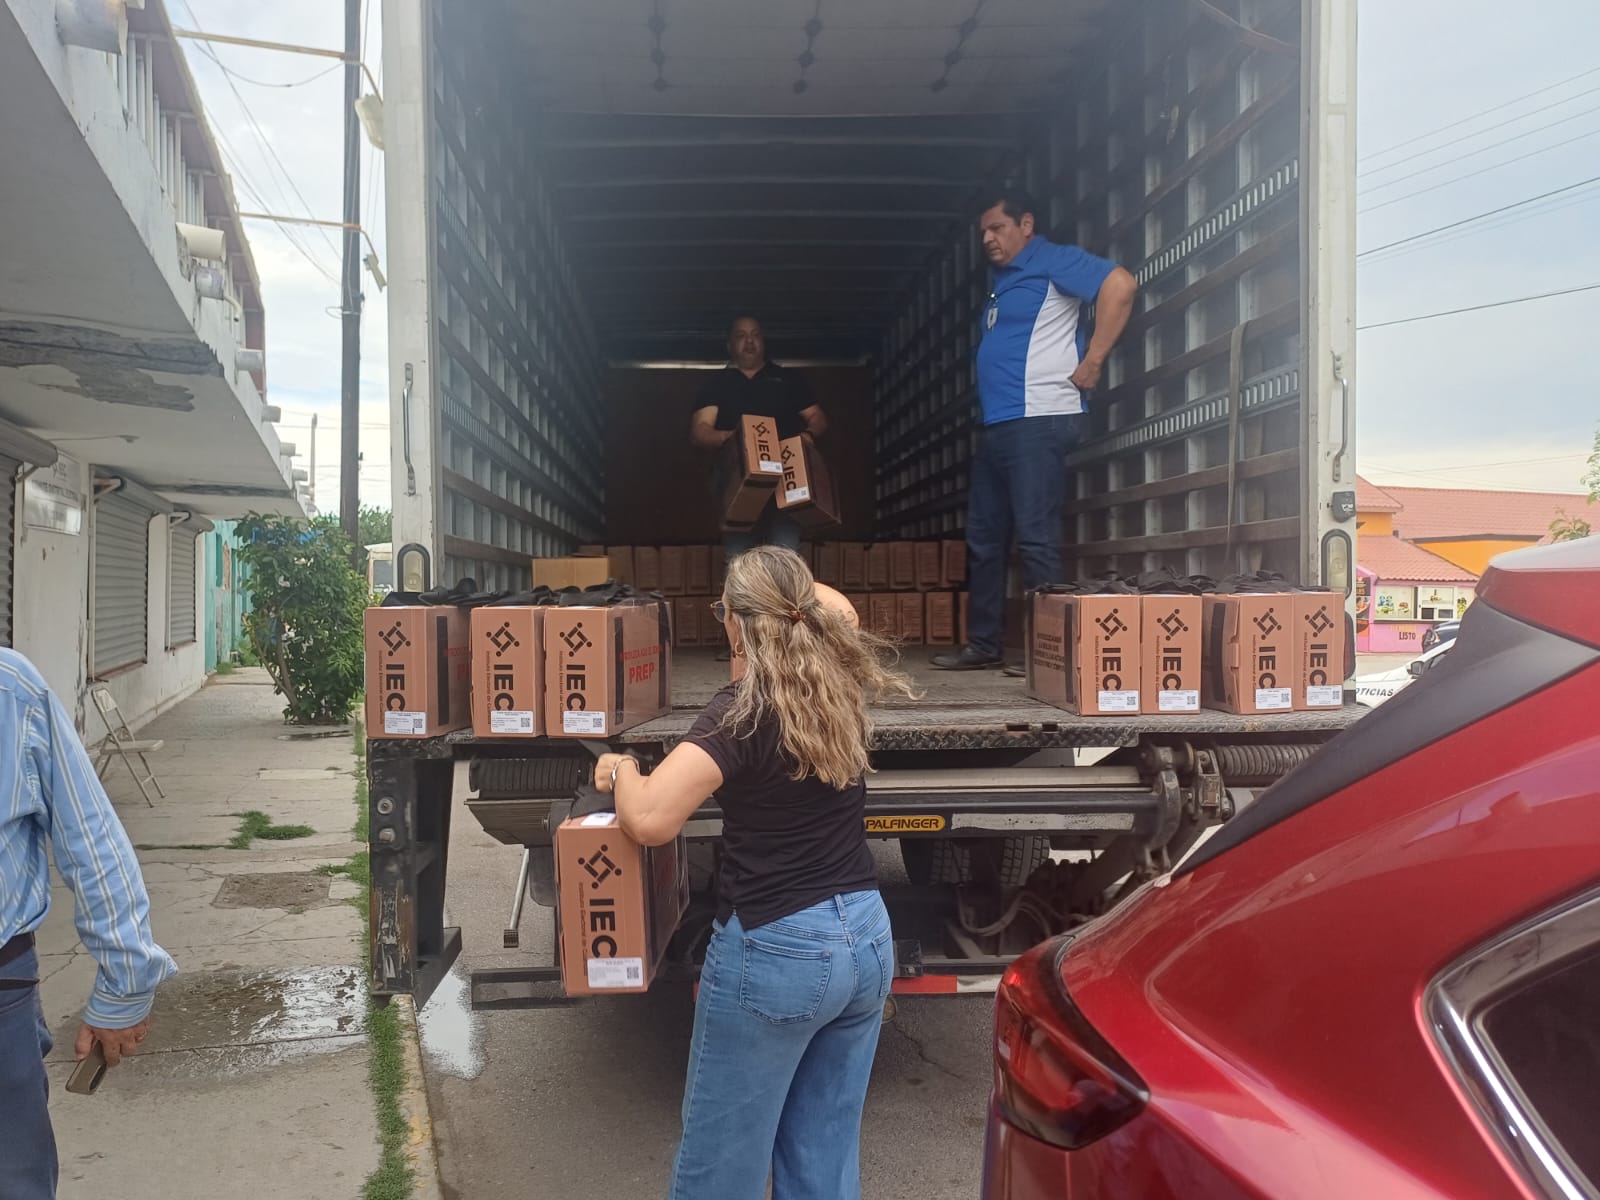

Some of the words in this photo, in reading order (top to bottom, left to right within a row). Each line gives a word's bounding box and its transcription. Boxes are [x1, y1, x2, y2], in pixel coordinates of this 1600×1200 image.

[757, 439, 771, 461] IEC
[783, 466, 797, 491] IEC
[1399, 632, 1416, 640] LISTO
[629, 662, 655, 684] PREP
[1102, 647, 1122, 690] IEC
[1162, 647, 1182, 691] IEC
[1258, 646, 1277, 689] IEC
[1309, 643, 1328, 686] IEC
[386, 663, 406, 712] IEC
[493, 663, 514, 712] IEC
[566, 663, 586, 712] IEC
[866, 818, 940, 829] PALFINGER
[589, 898, 617, 958] IEC
